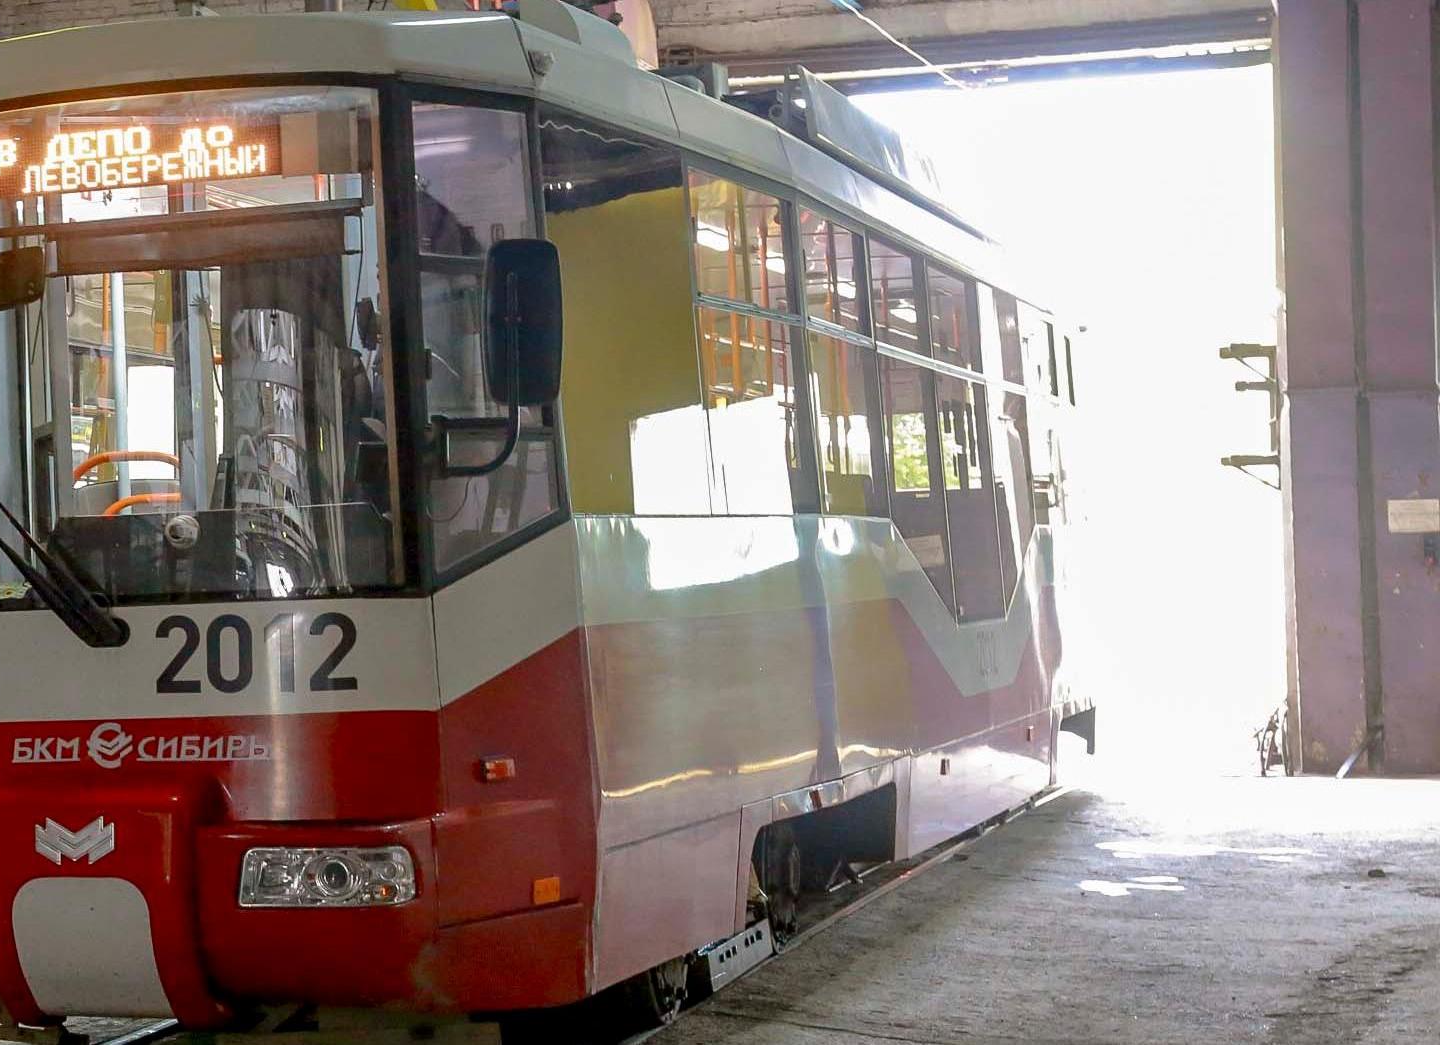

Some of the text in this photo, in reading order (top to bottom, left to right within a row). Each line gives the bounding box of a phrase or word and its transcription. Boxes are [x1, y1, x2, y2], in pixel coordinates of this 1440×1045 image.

[44, 126, 152, 164] ДЕПО
[21, 143, 267, 194] ЛЕВОБЕРЕЖНЫЙ
[155, 612, 358, 693] 2012
[12, 735, 272, 763] БКМ СИБИРЬ
